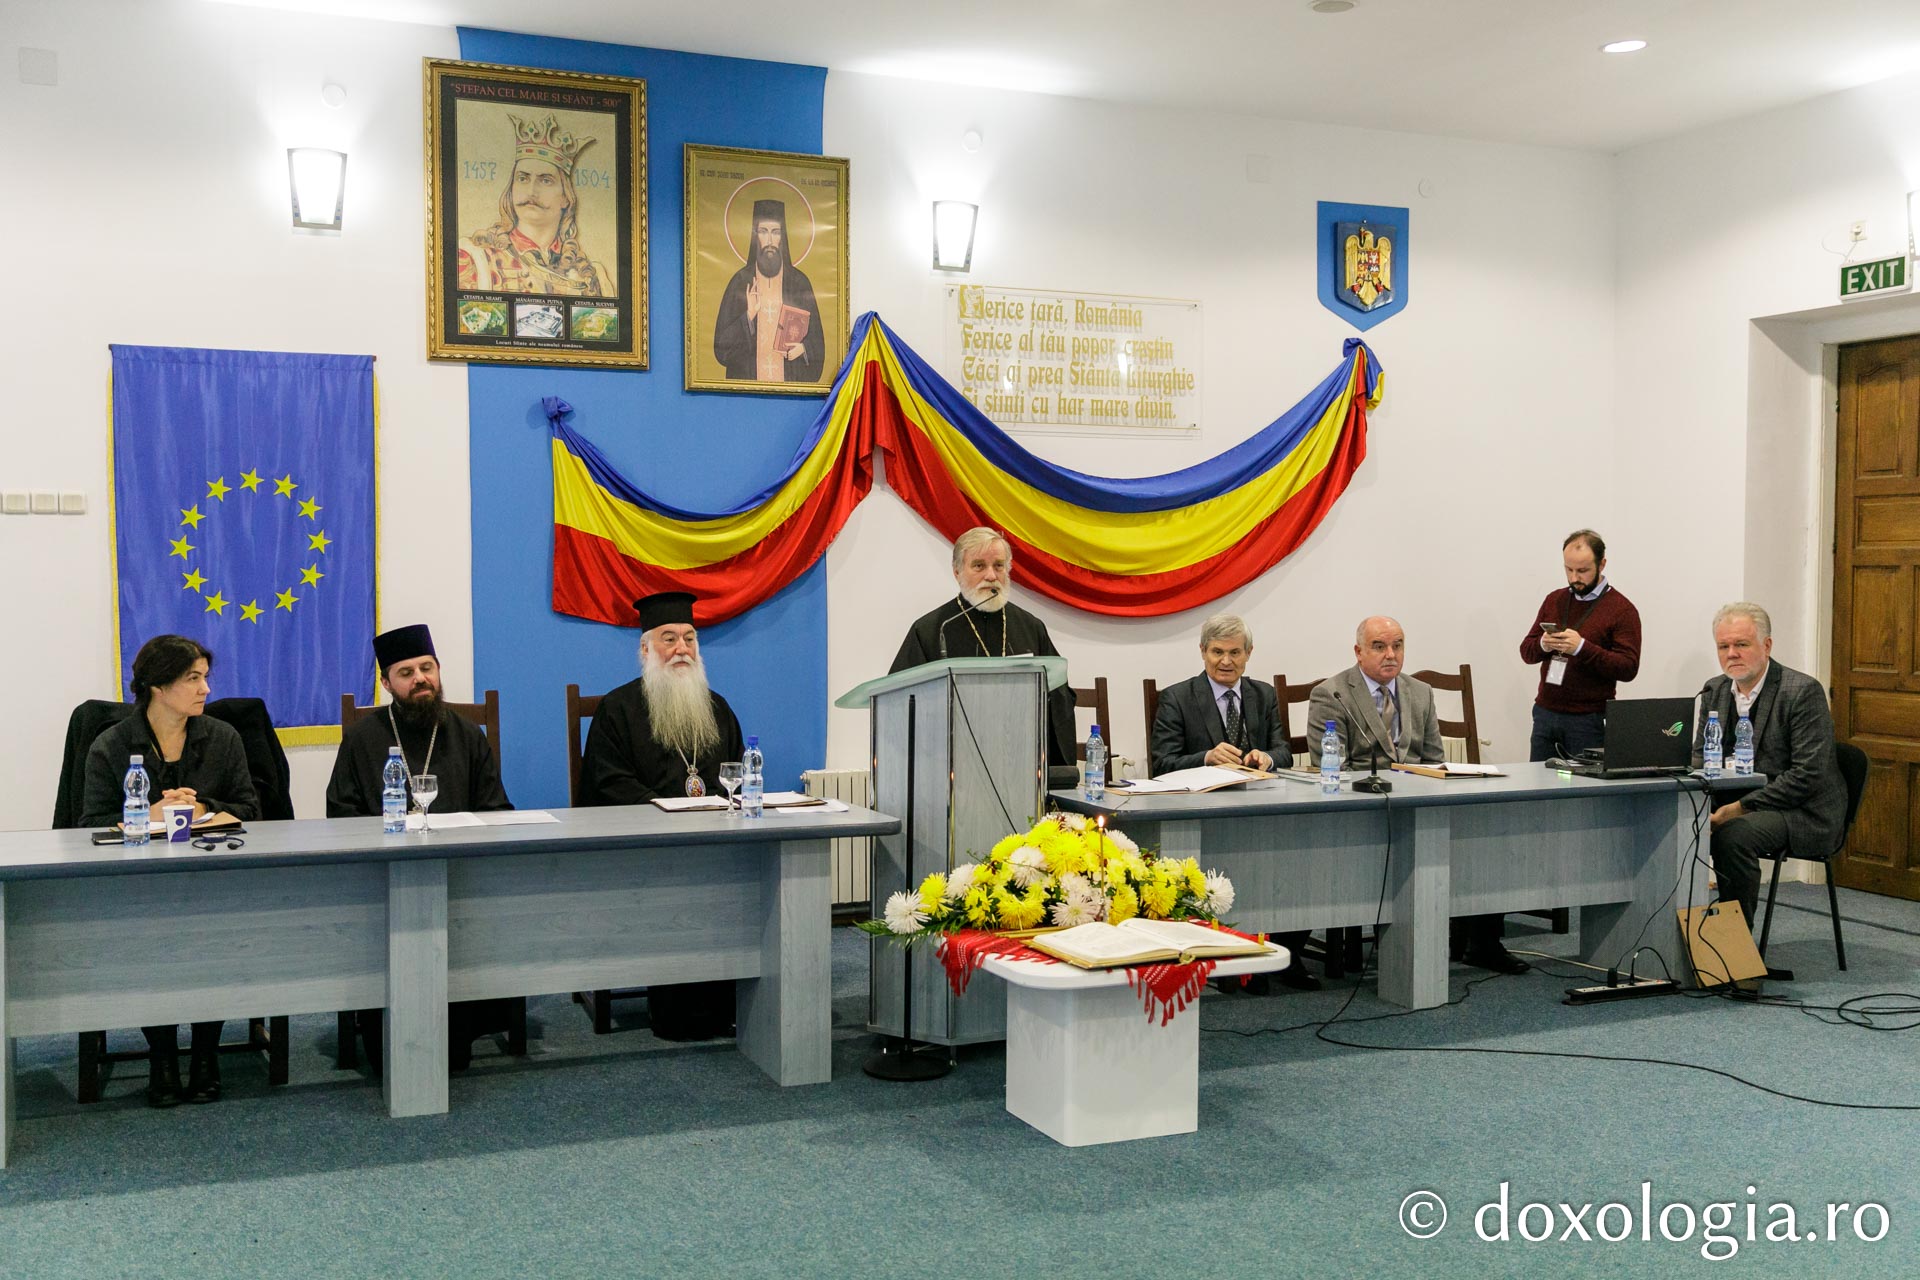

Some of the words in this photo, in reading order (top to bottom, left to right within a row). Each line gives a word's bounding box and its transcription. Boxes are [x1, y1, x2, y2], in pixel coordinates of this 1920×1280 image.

[497, 87, 517, 98] CEL
[519, 89, 548, 101] MARE
[463, 160, 497, 181] 1457
[574, 168, 610, 189] 1504
[1847, 261, 1899, 294] EXIT
[1075, 299, 1142, 327] România
[963, 323, 1013, 350] Ferice
[1019, 329, 1033, 352] al
[1040, 330, 1065, 353] tău
[1072, 336, 1116, 360] popor
[962, 356, 999, 382] Căci
[1006, 360, 1021, 383] ai
[1028, 366, 1063, 389] prea
[1127, 364, 1195, 395] Liturghie
[1032, 395, 1049, 415] cu
[1058, 391, 1084, 416] har
[1090, 397, 1129, 417] mare
